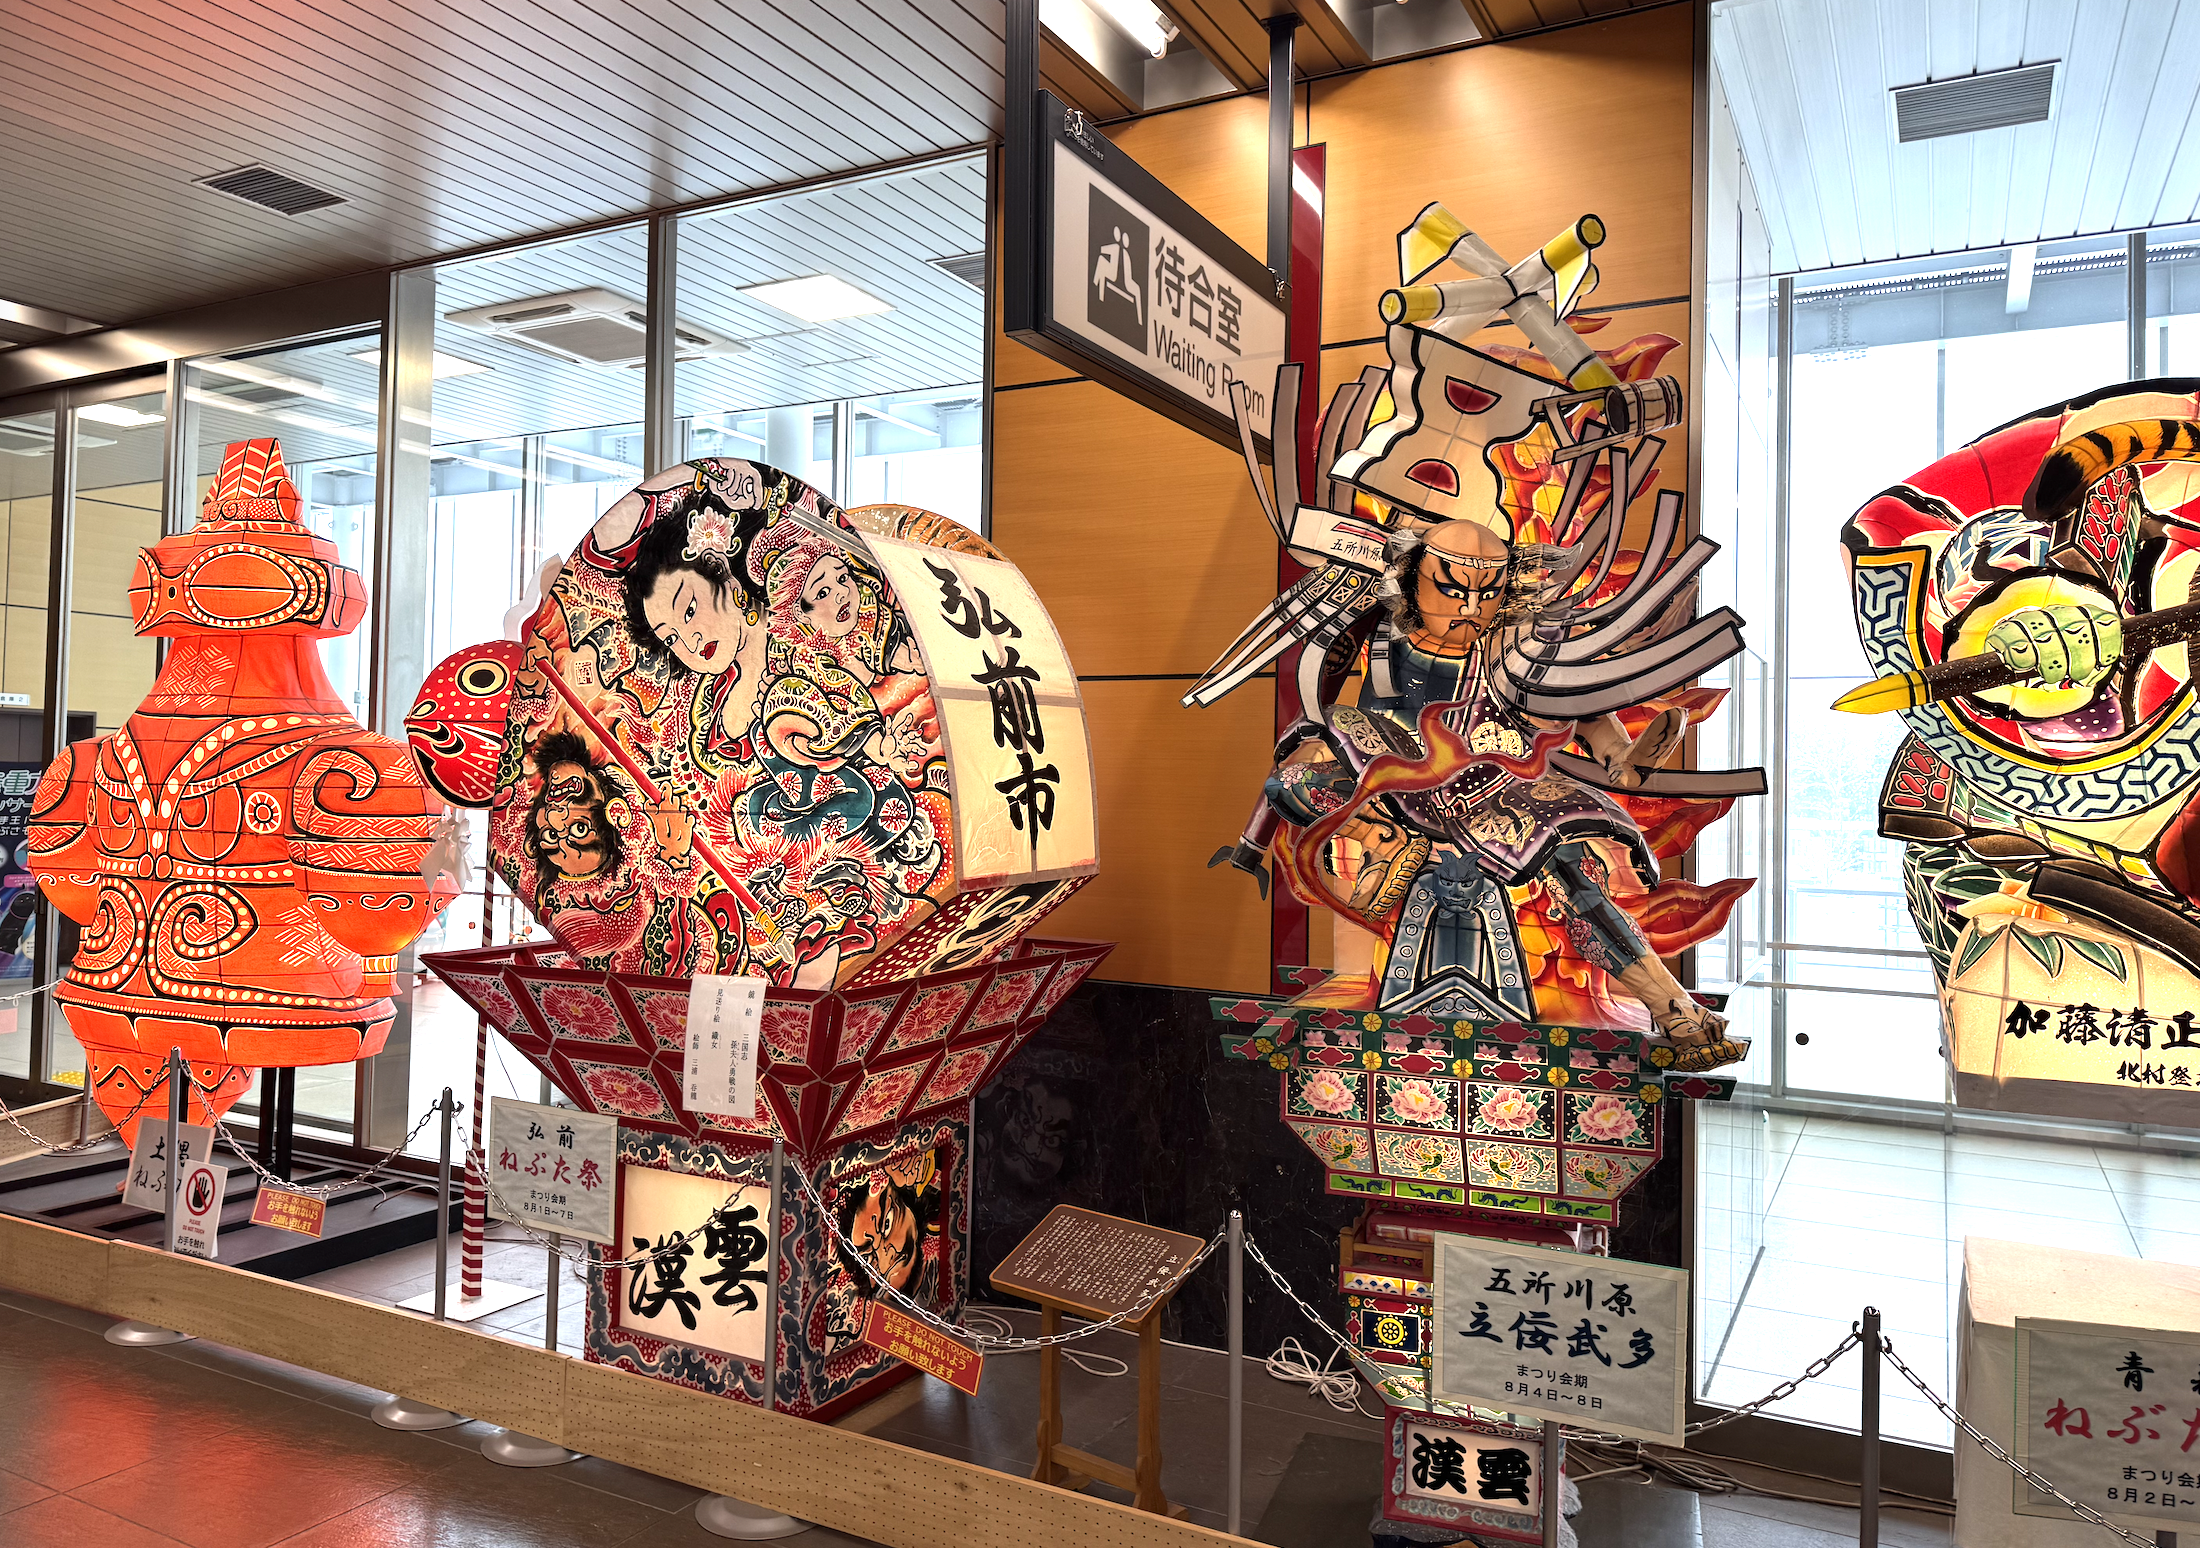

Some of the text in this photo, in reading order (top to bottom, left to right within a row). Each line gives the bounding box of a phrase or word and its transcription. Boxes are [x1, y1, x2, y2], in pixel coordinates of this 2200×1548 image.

[1155, 236, 1242, 357] 待合室
[1153, 319, 1265, 419] Waiting Rom
[1330, 538, 1382, 562] 五所川原
[922, 557, 1060, 851] 弘前市
[526, 1121, 576, 1150] 弘前
[499, 1146, 603, 1191] ねぷた祭
[267, 1192, 290, 1202] PLEASE
[267, 1200, 319, 1220] お手を触れないよう
[529, 1189, 567, 1206] まつり会期
[270, 1213, 312, 1231] お願い致します
[1483, 1267, 1637, 1318] 五所川原
[883, 1310, 974, 1362] PLEASE DO NOT TOUCH
[883, 1321, 967, 1371] お手を触れないよう
[1458, 1301, 1656, 1369] 立佞武多
[889, 1340, 956, 1379] お願い致します
[1516, 1364, 1588, 1389] まつり会期
[2122, 1465, 2200, 1489] まつり会
